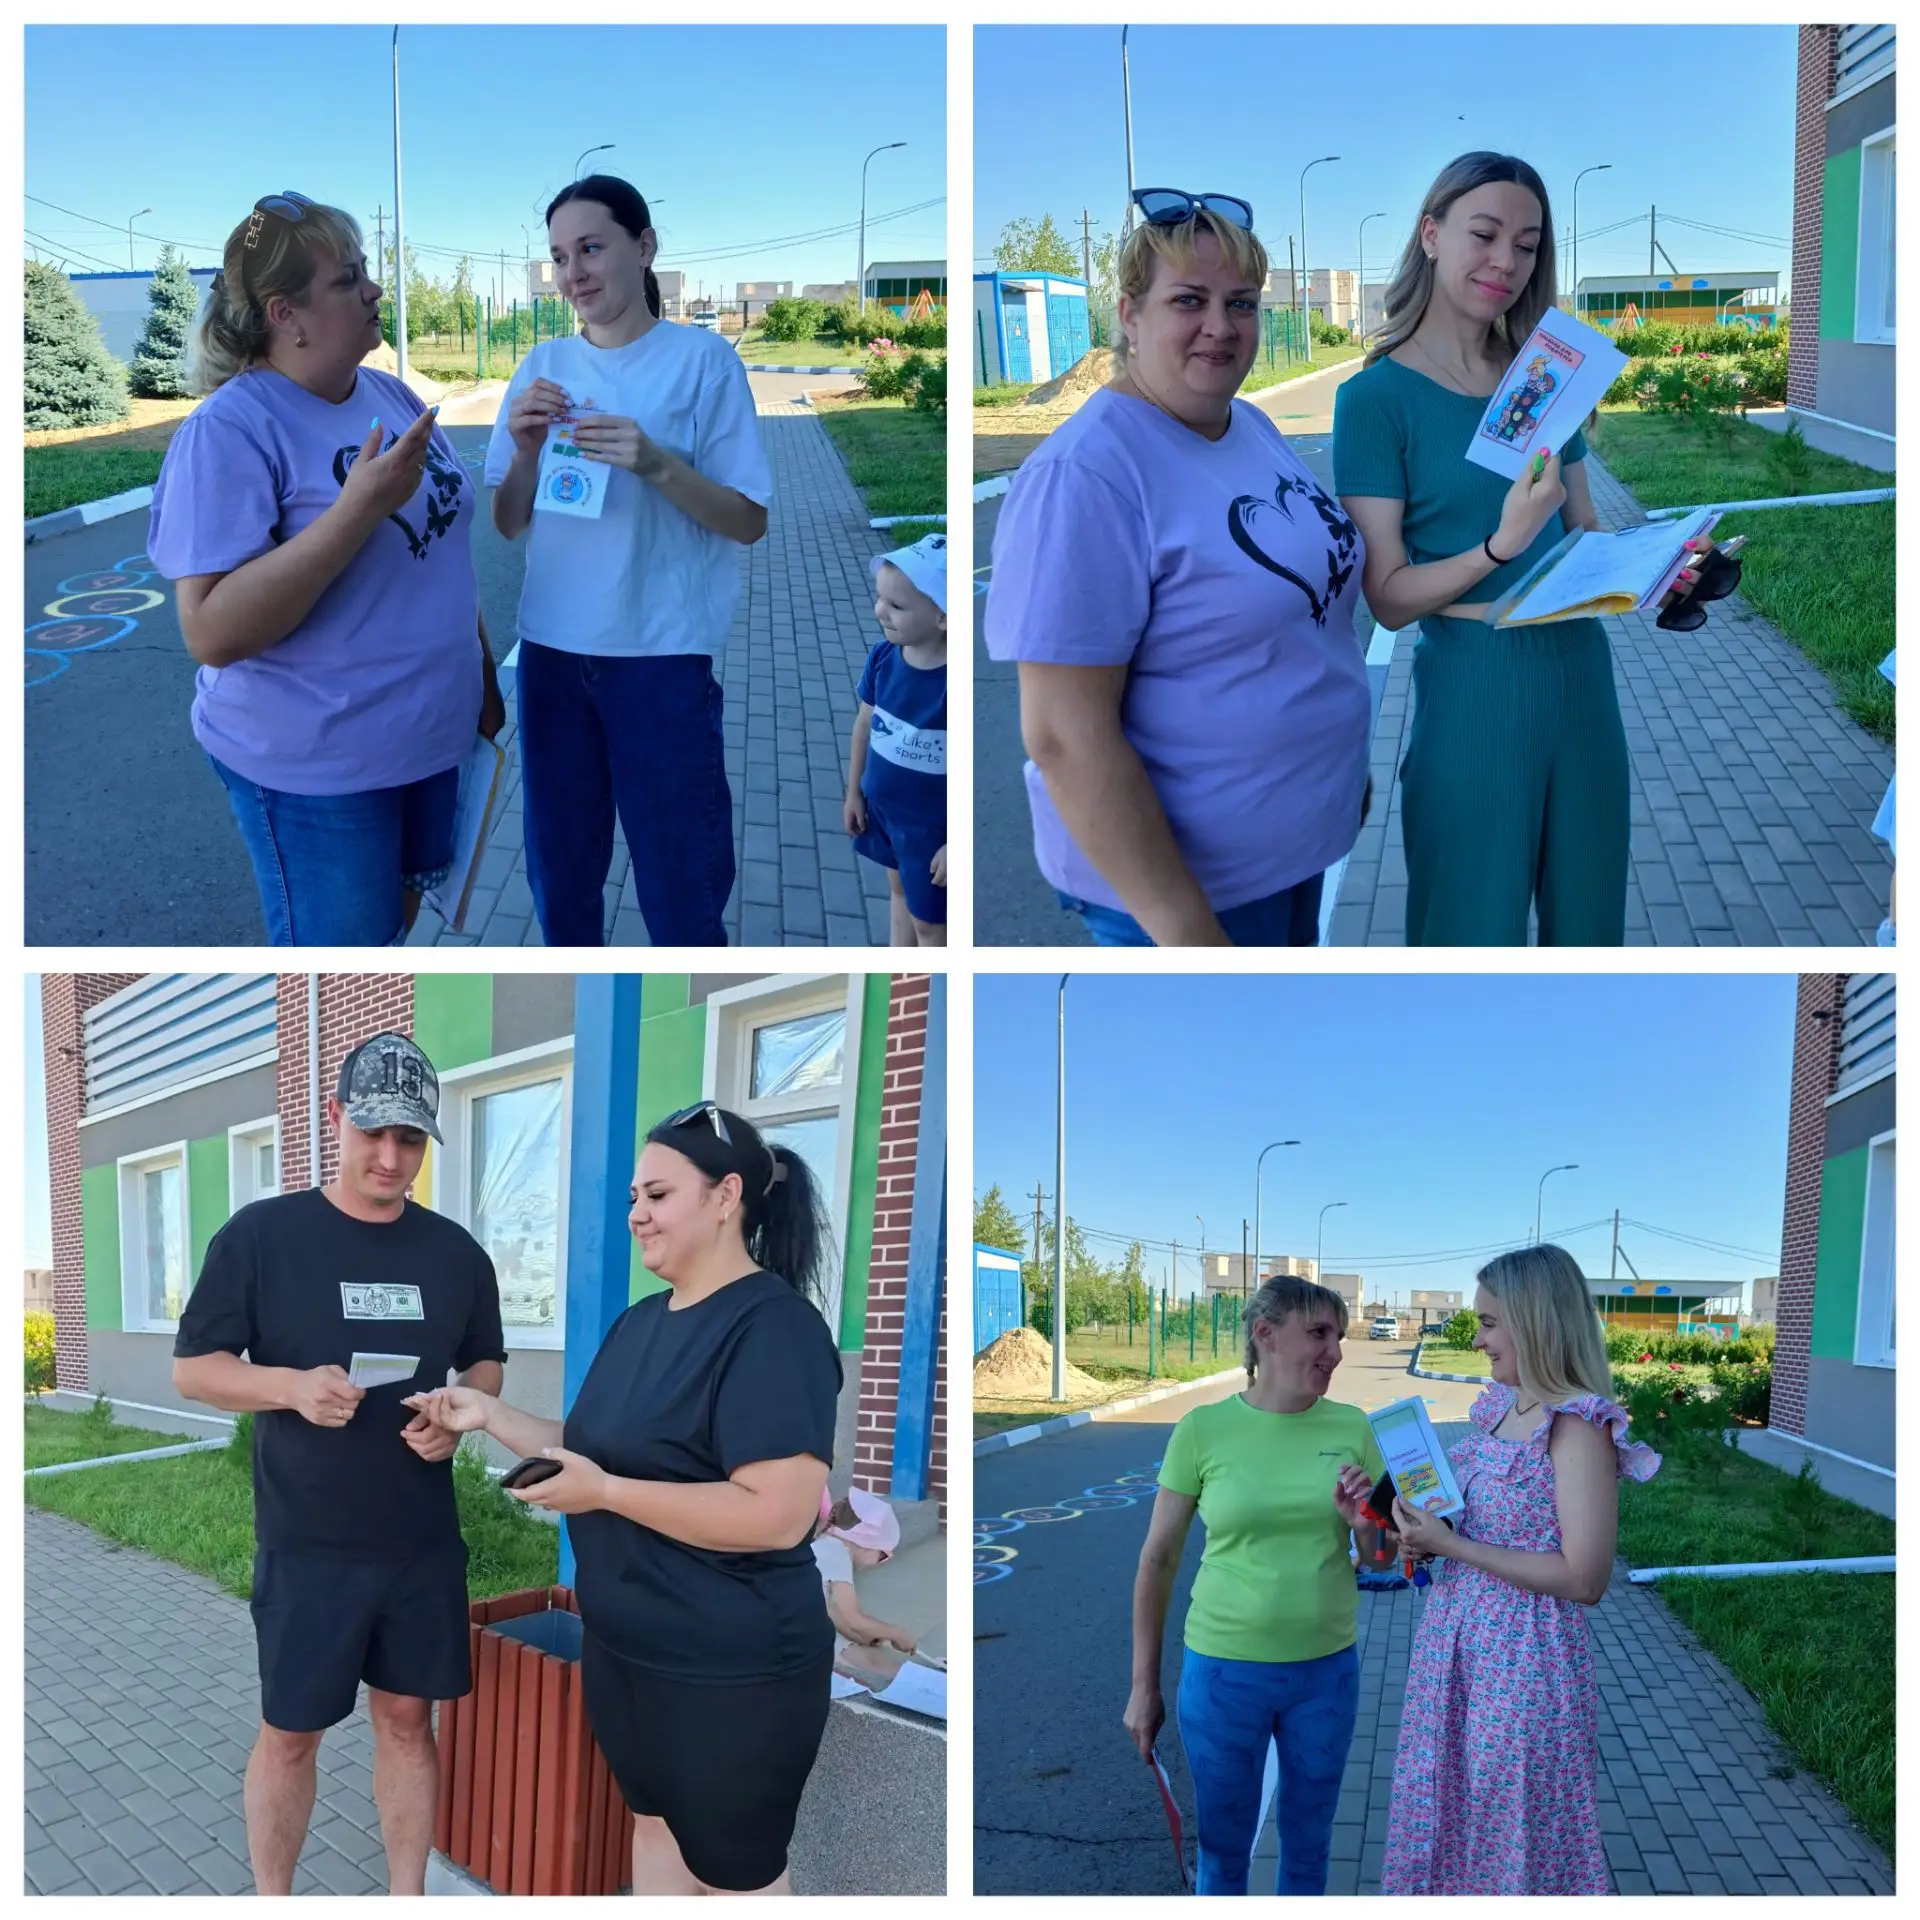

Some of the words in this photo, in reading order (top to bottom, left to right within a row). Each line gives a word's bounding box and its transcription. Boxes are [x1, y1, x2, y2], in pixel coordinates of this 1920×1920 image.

[902, 734, 932, 751] Like
[894, 746, 941, 764] sports
[380, 1051, 424, 1101] 13
